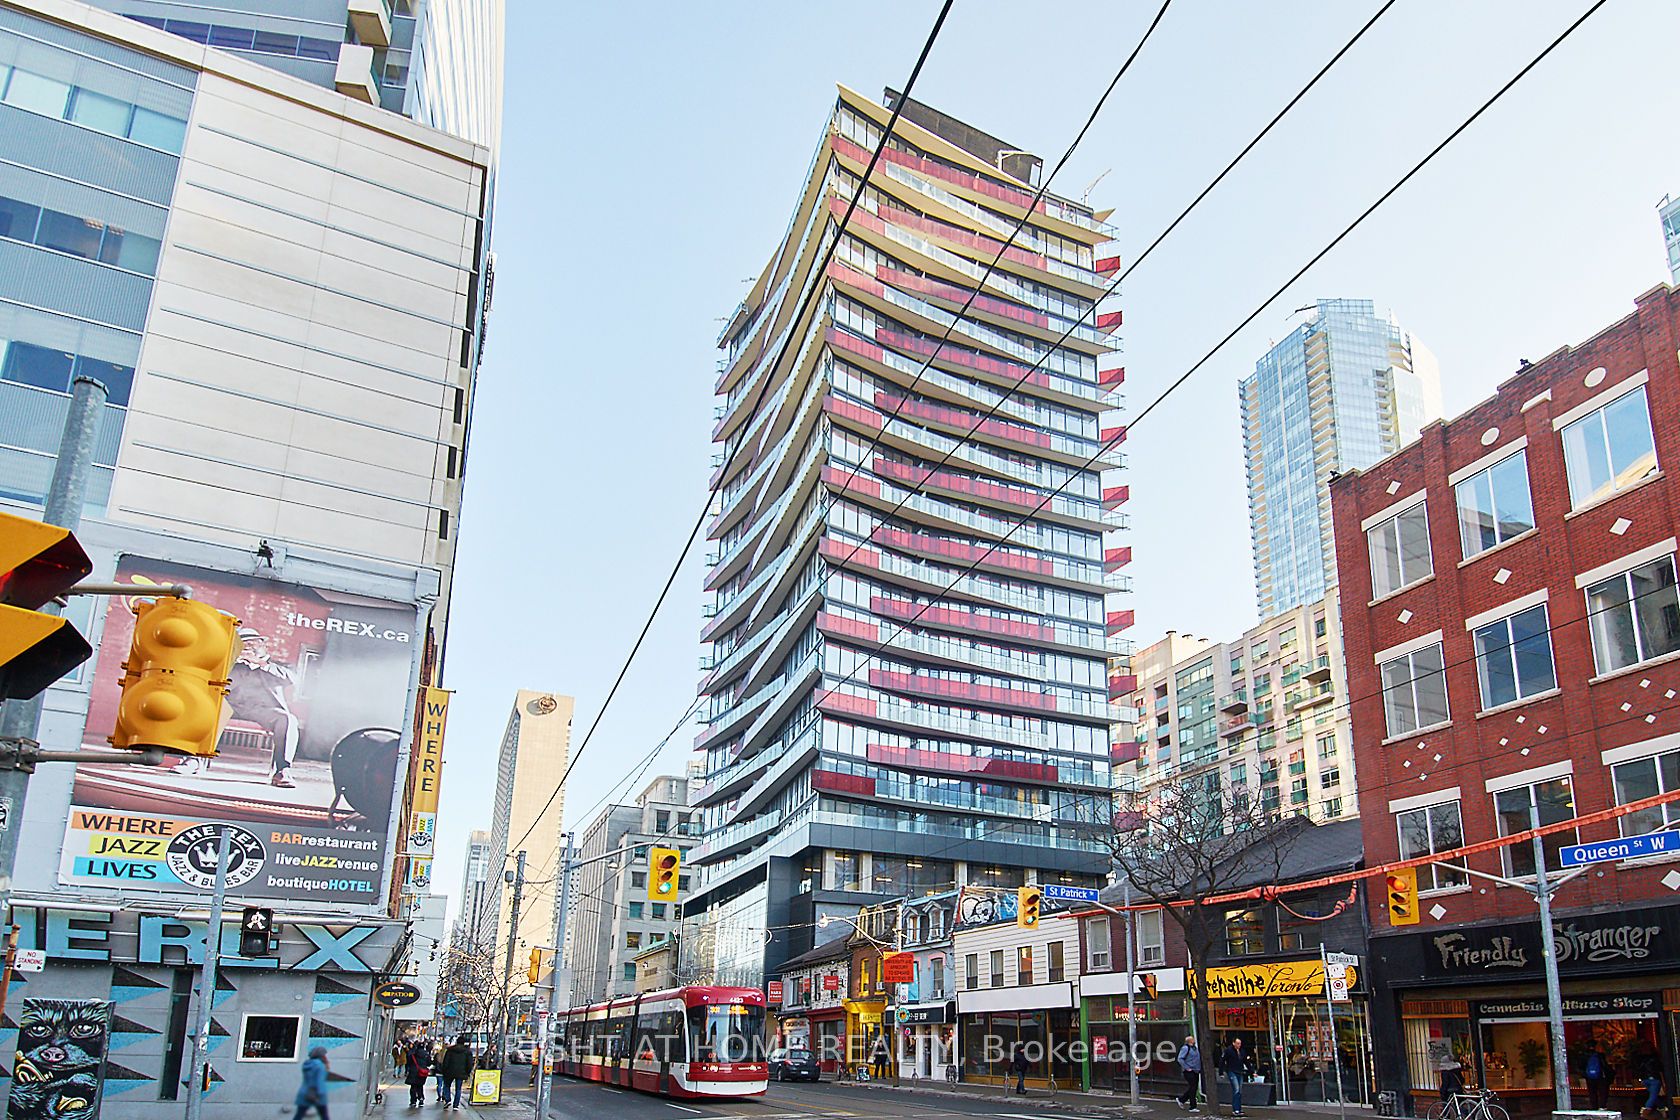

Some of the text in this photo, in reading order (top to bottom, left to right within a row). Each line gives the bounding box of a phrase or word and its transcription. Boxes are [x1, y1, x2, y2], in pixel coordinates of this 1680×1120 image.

[287, 612, 409, 643] theREX.ca
[421, 702, 446, 792] WHERE
[81, 814, 174, 836] WHERE
[95, 837, 161, 856] JAZZ
[175, 825, 260, 853] THE REX
[270, 831, 378, 851] BARrestaurant
[1573, 836, 1665, 862] Queen St W
[88, 860, 157, 880] LIVES
[172, 855, 191, 877] JAZZ
[201, 874, 240, 886] BLES
[240, 860, 259, 878] BAR
[275, 853, 378, 871] liveJAZZvenue
[267, 875, 374, 893] boutiqueHOTEL
[1050, 887, 1058, 896] St
[1060, 888, 1088, 899] Patrick
[1433, 922, 1660, 968] Friendly Stranger
[18, 957, 43, 966] STANDING
[1189, 968, 1266, 999] Arenaline
[1264, 965, 1324, 997] Toronto
[1480, 996, 1653, 1014] Cannabis ulture Shop
